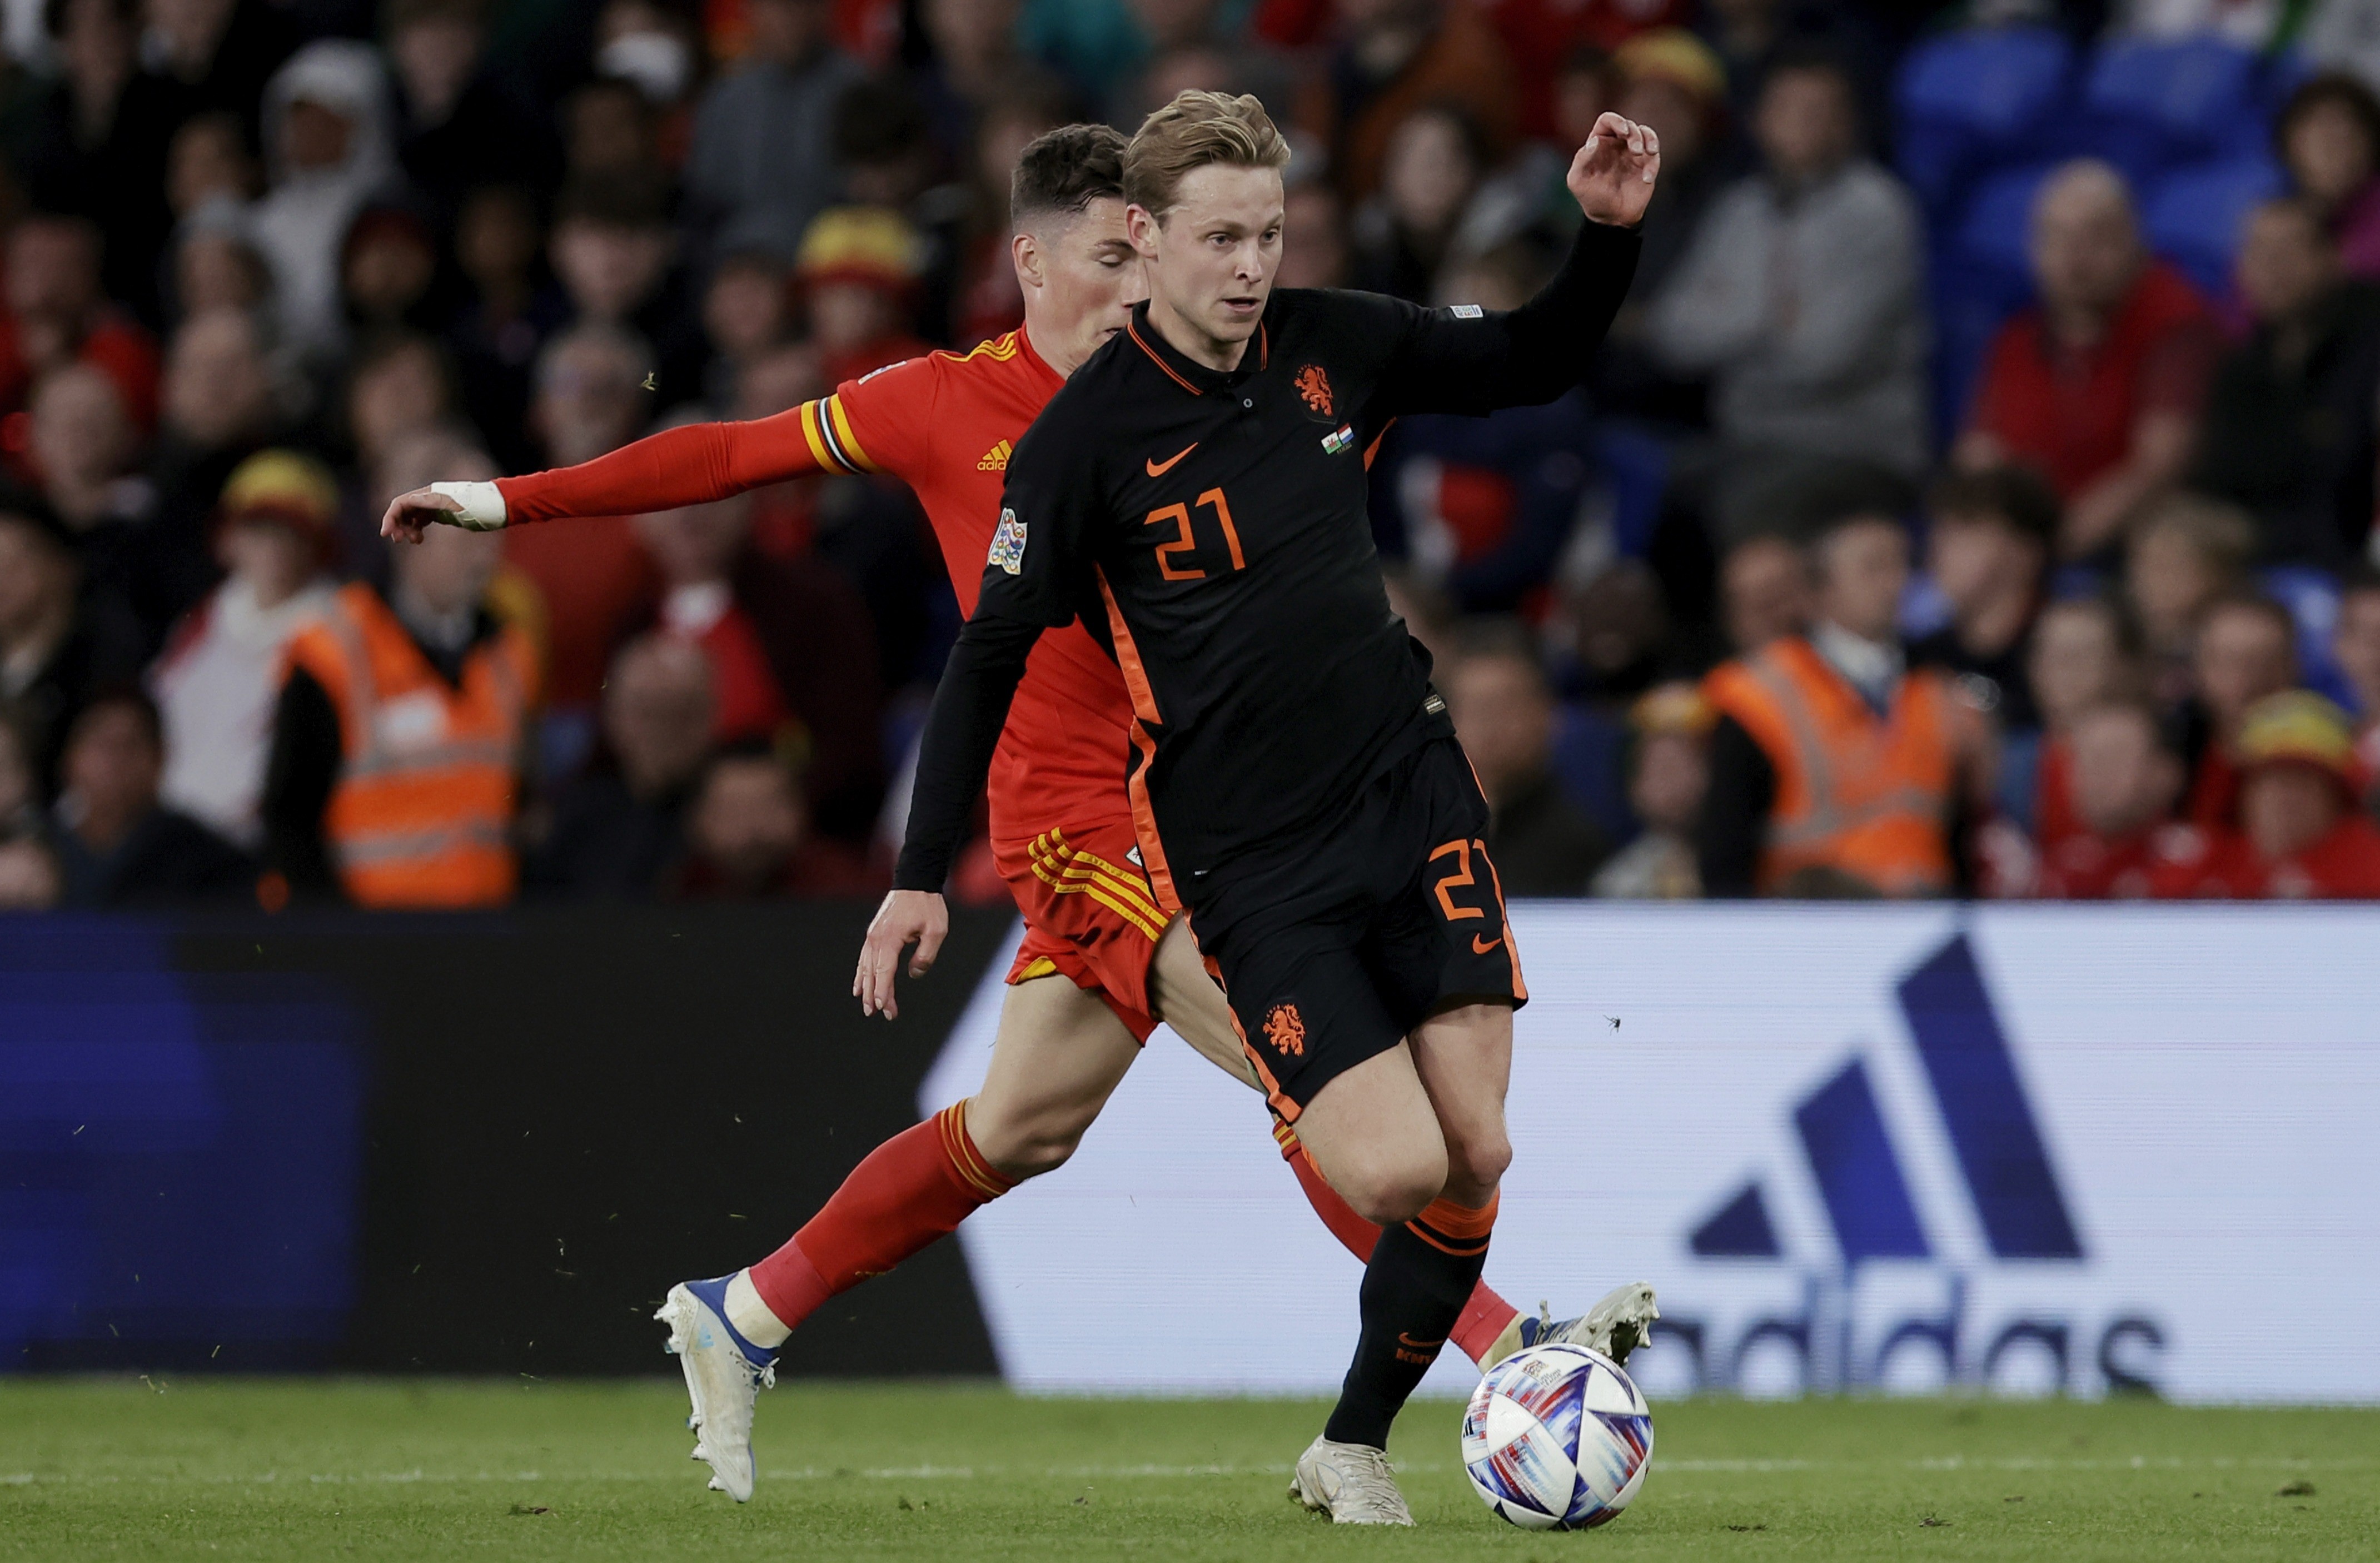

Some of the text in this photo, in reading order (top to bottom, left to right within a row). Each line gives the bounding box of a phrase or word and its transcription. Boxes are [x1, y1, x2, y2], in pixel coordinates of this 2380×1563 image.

[977, 459, 1007, 471] adid
[1143, 487, 1246, 581] 21
[1428, 838, 1507, 922] 21
